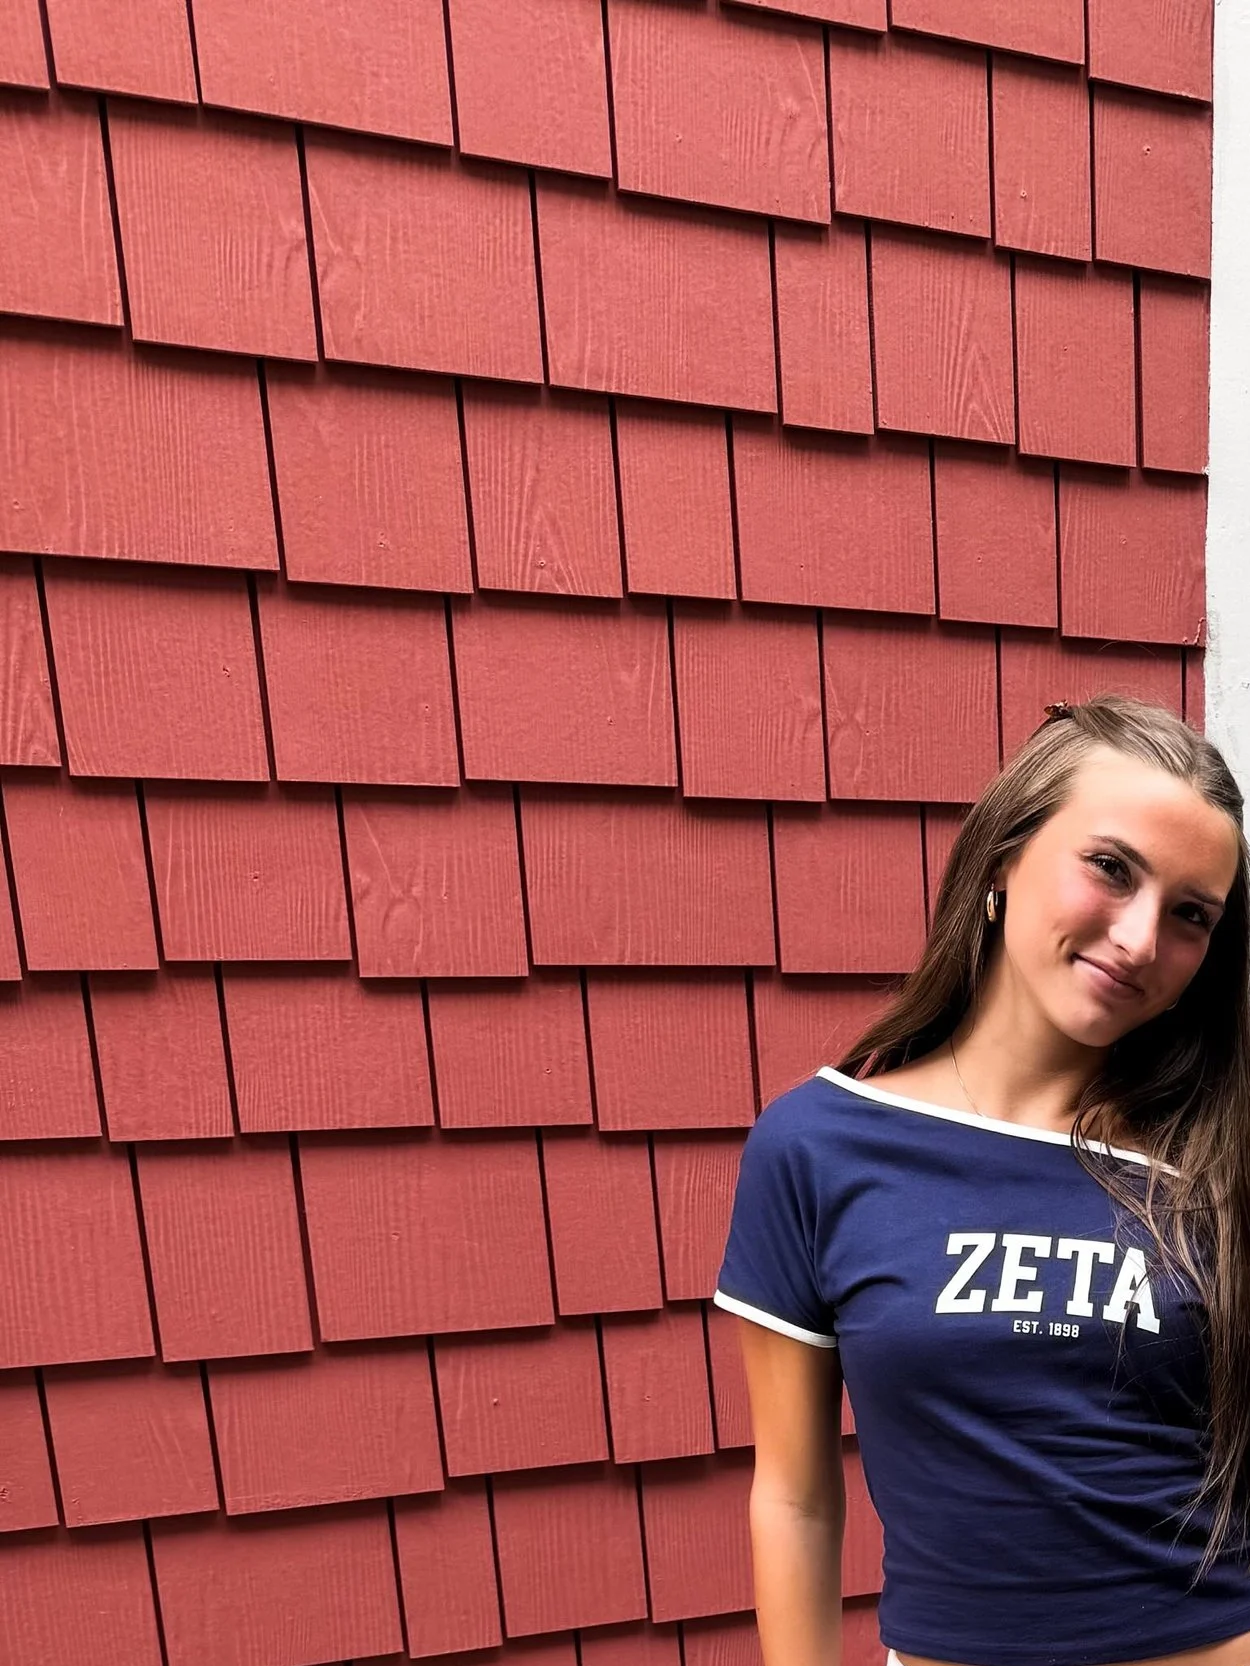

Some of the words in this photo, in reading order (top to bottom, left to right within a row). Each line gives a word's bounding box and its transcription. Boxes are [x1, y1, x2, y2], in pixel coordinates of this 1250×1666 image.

[935, 1232, 1161, 1334] ZETA
[1013, 1320, 1043, 1335] EST.
[1048, 1322, 1080, 1338] 1898
